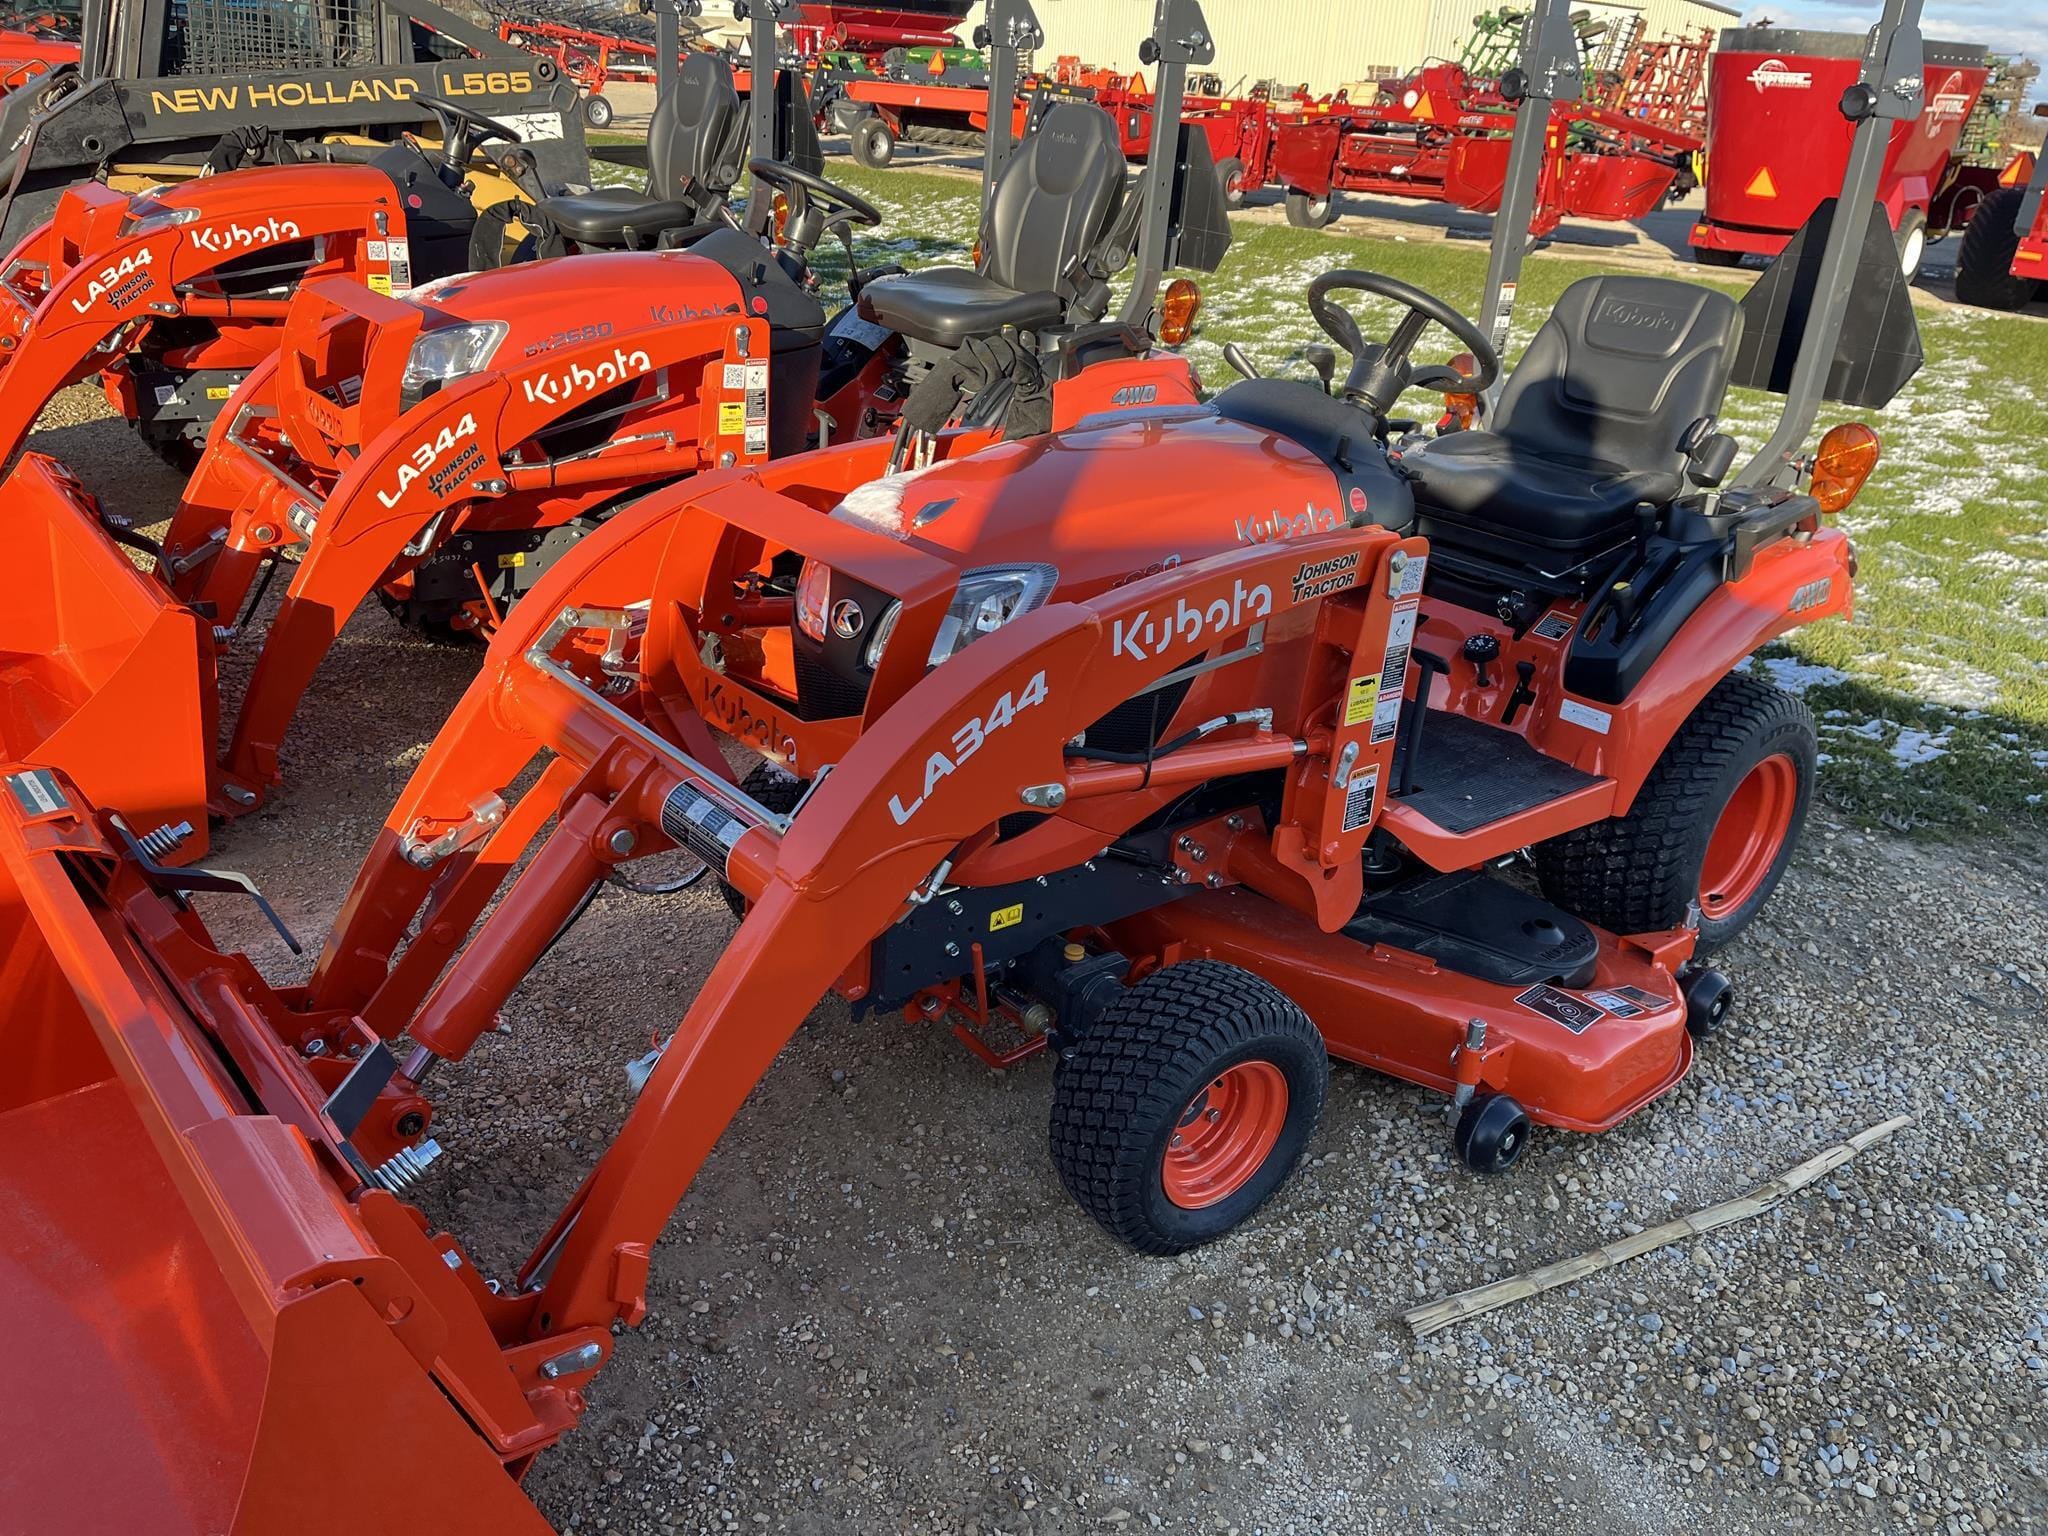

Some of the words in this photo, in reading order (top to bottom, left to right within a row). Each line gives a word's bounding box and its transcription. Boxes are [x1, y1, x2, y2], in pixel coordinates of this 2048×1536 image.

[151, 87, 238, 114] NEW
[249, 77, 419, 107] HOLLAND
[443, 71, 532, 96] L565
[189, 216, 301, 252] Kubota
[71, 247, 153, 314] LA344
[106, 269, 149, 304] JOHNSON
[111, 278, 155, 311] TRACTOR
[1604, 303, 1679, 332] Kubota
[523, 321, 614, 358] BX2680
[522, 348, 652, 405] Kubota
[1111, 384, 1158, 406] 4WD
[376, 412, 479, 509] LA344
[427, 443, 480, 491] JOHNSON
[432, 453, 488, 500] TRACTOR
[1234, 502, 1336, 545] Kubota
[1291, 553, 1359, 585] JOHNSON
[1291, 572, 1355, 604] TRACTOR
[1787, 577, 1832, 613] 4WD
[1113, 578, 1273, 661] Kubota
[704, 676, 797, 763] Kubota
[887, 669, 1049, 826] LA344
